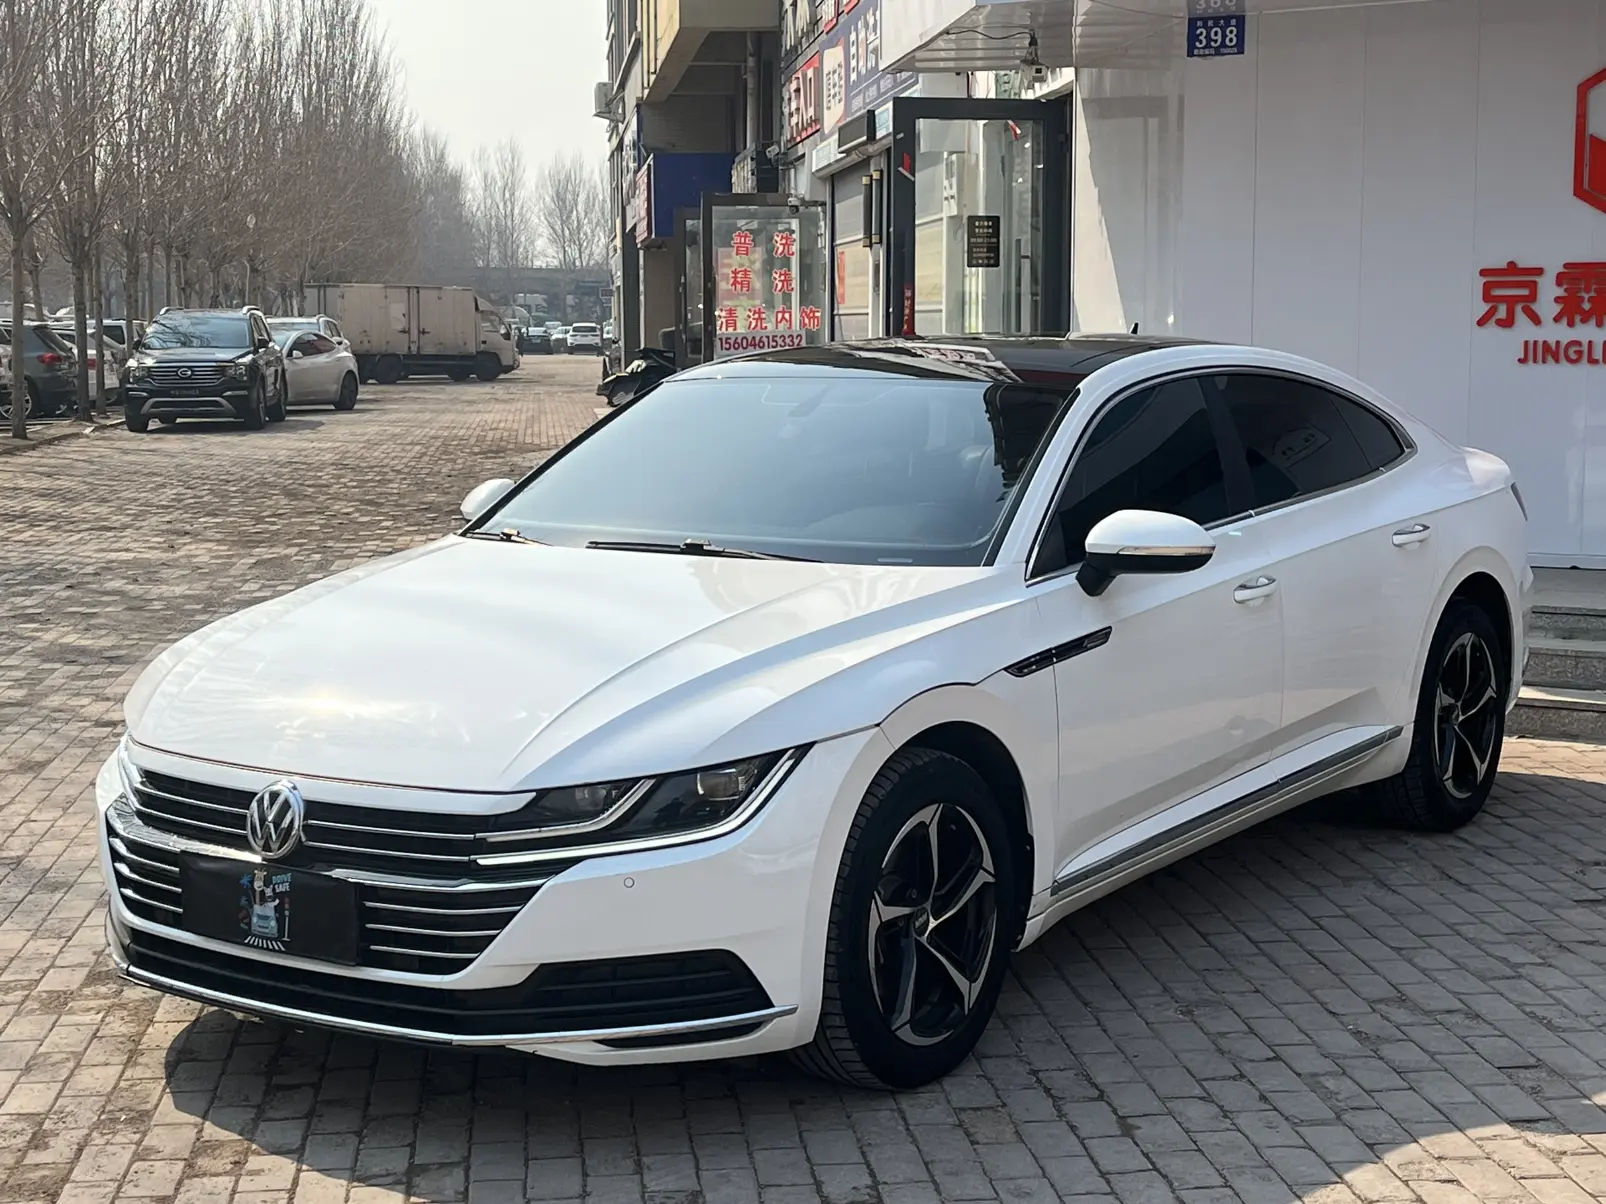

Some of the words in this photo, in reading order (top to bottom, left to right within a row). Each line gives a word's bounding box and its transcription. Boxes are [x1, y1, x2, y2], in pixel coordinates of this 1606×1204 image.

[1195, 26, 1237, 48] 398
[716, 304, 822, 332] 清洗内饰
[718, 334, 803, 351] 15604615332
[1517, 340, 1606, 364] JINGL
[272, 873, 292, 884] DRIVE
[274, 882, 291, 893] SAFE
